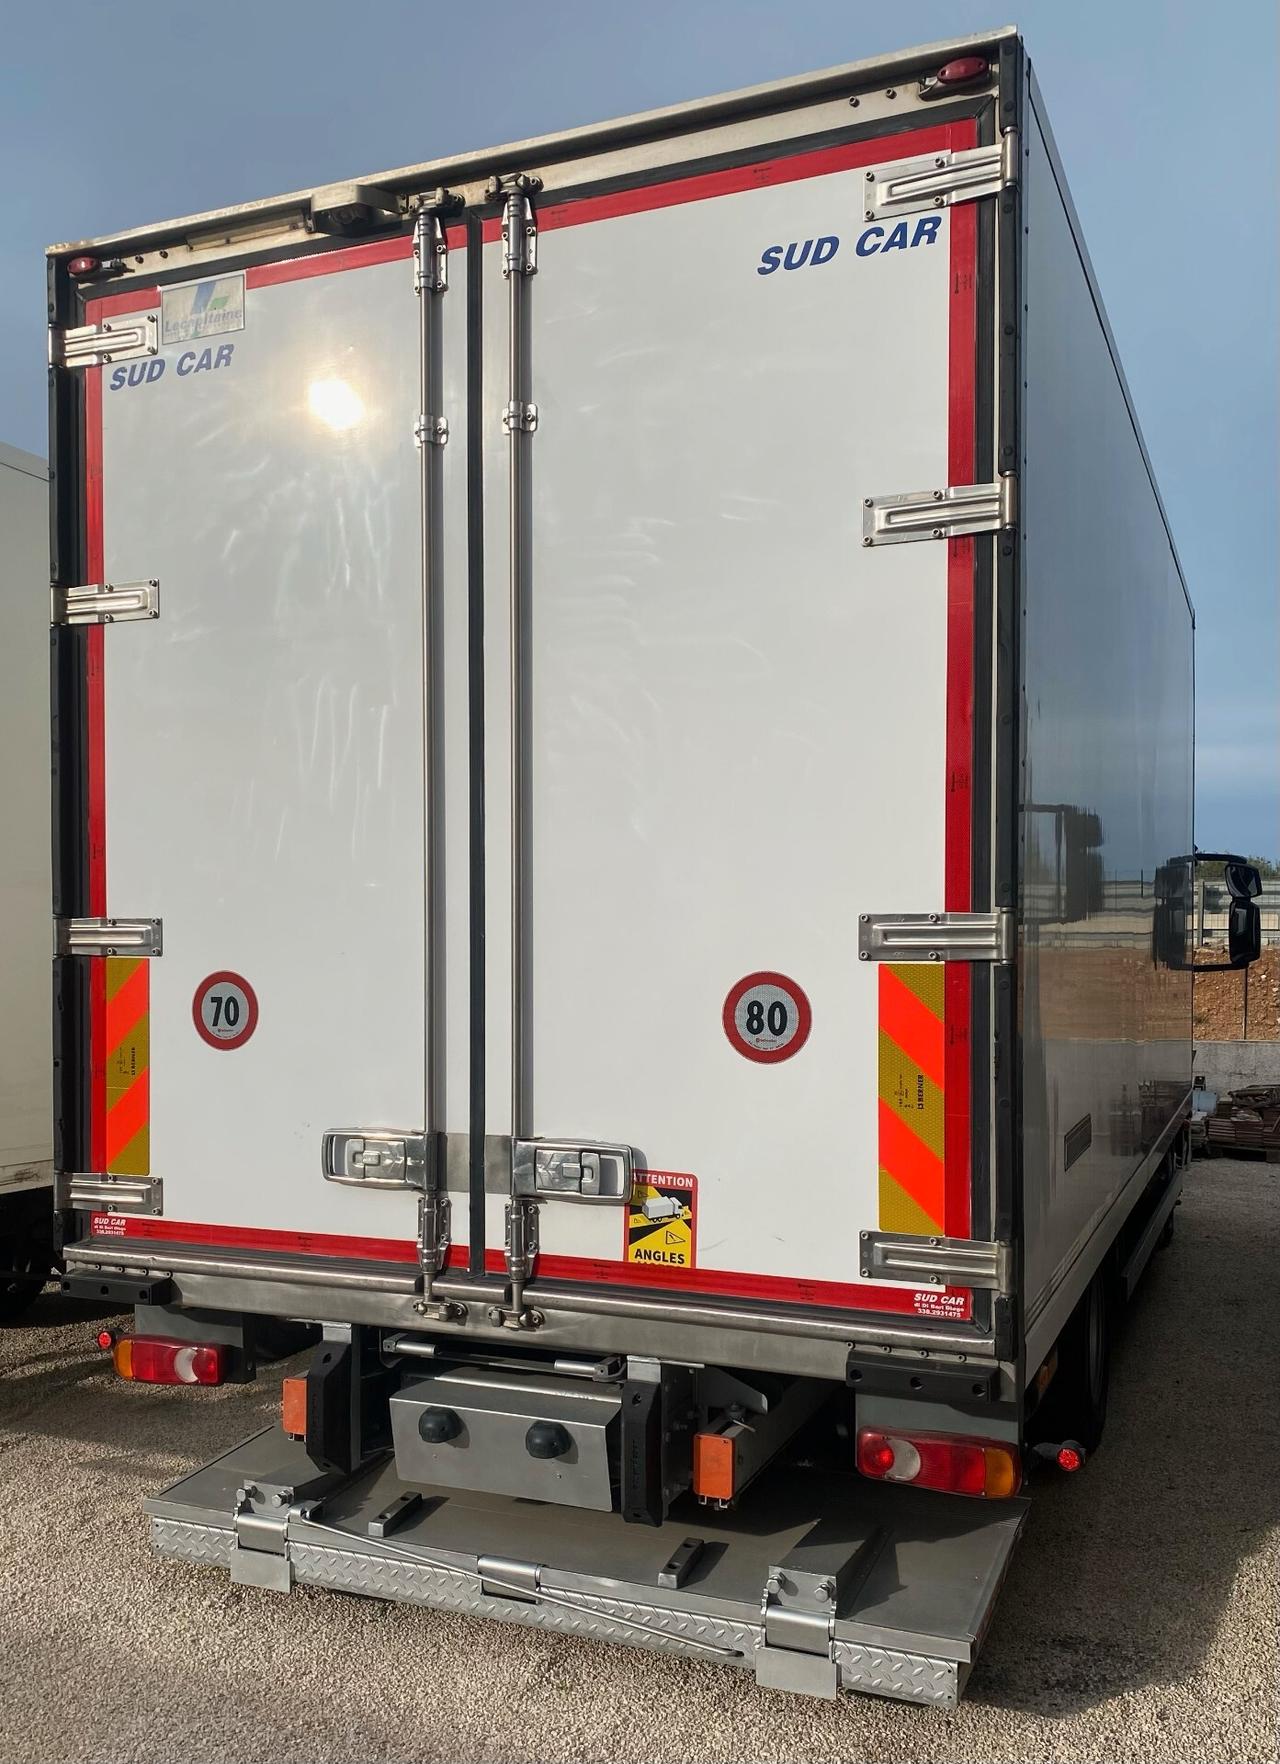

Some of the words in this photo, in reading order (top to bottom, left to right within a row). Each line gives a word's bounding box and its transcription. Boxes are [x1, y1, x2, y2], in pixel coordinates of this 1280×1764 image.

[757, 236, 840, 275] SUD
[855, 216, 942, 257] CAR
[109, 358, 166, 391] SUD
[176, 343, 234, 376] CAR
[210, 995, 240, 1027] 70
[746, 1000, 788, 1037] 80
[634, 1248, 685, 1265] ANGLES
[914, 1293, 938, 1302] SUD
[940, 1296, 964, 1305] CAR
